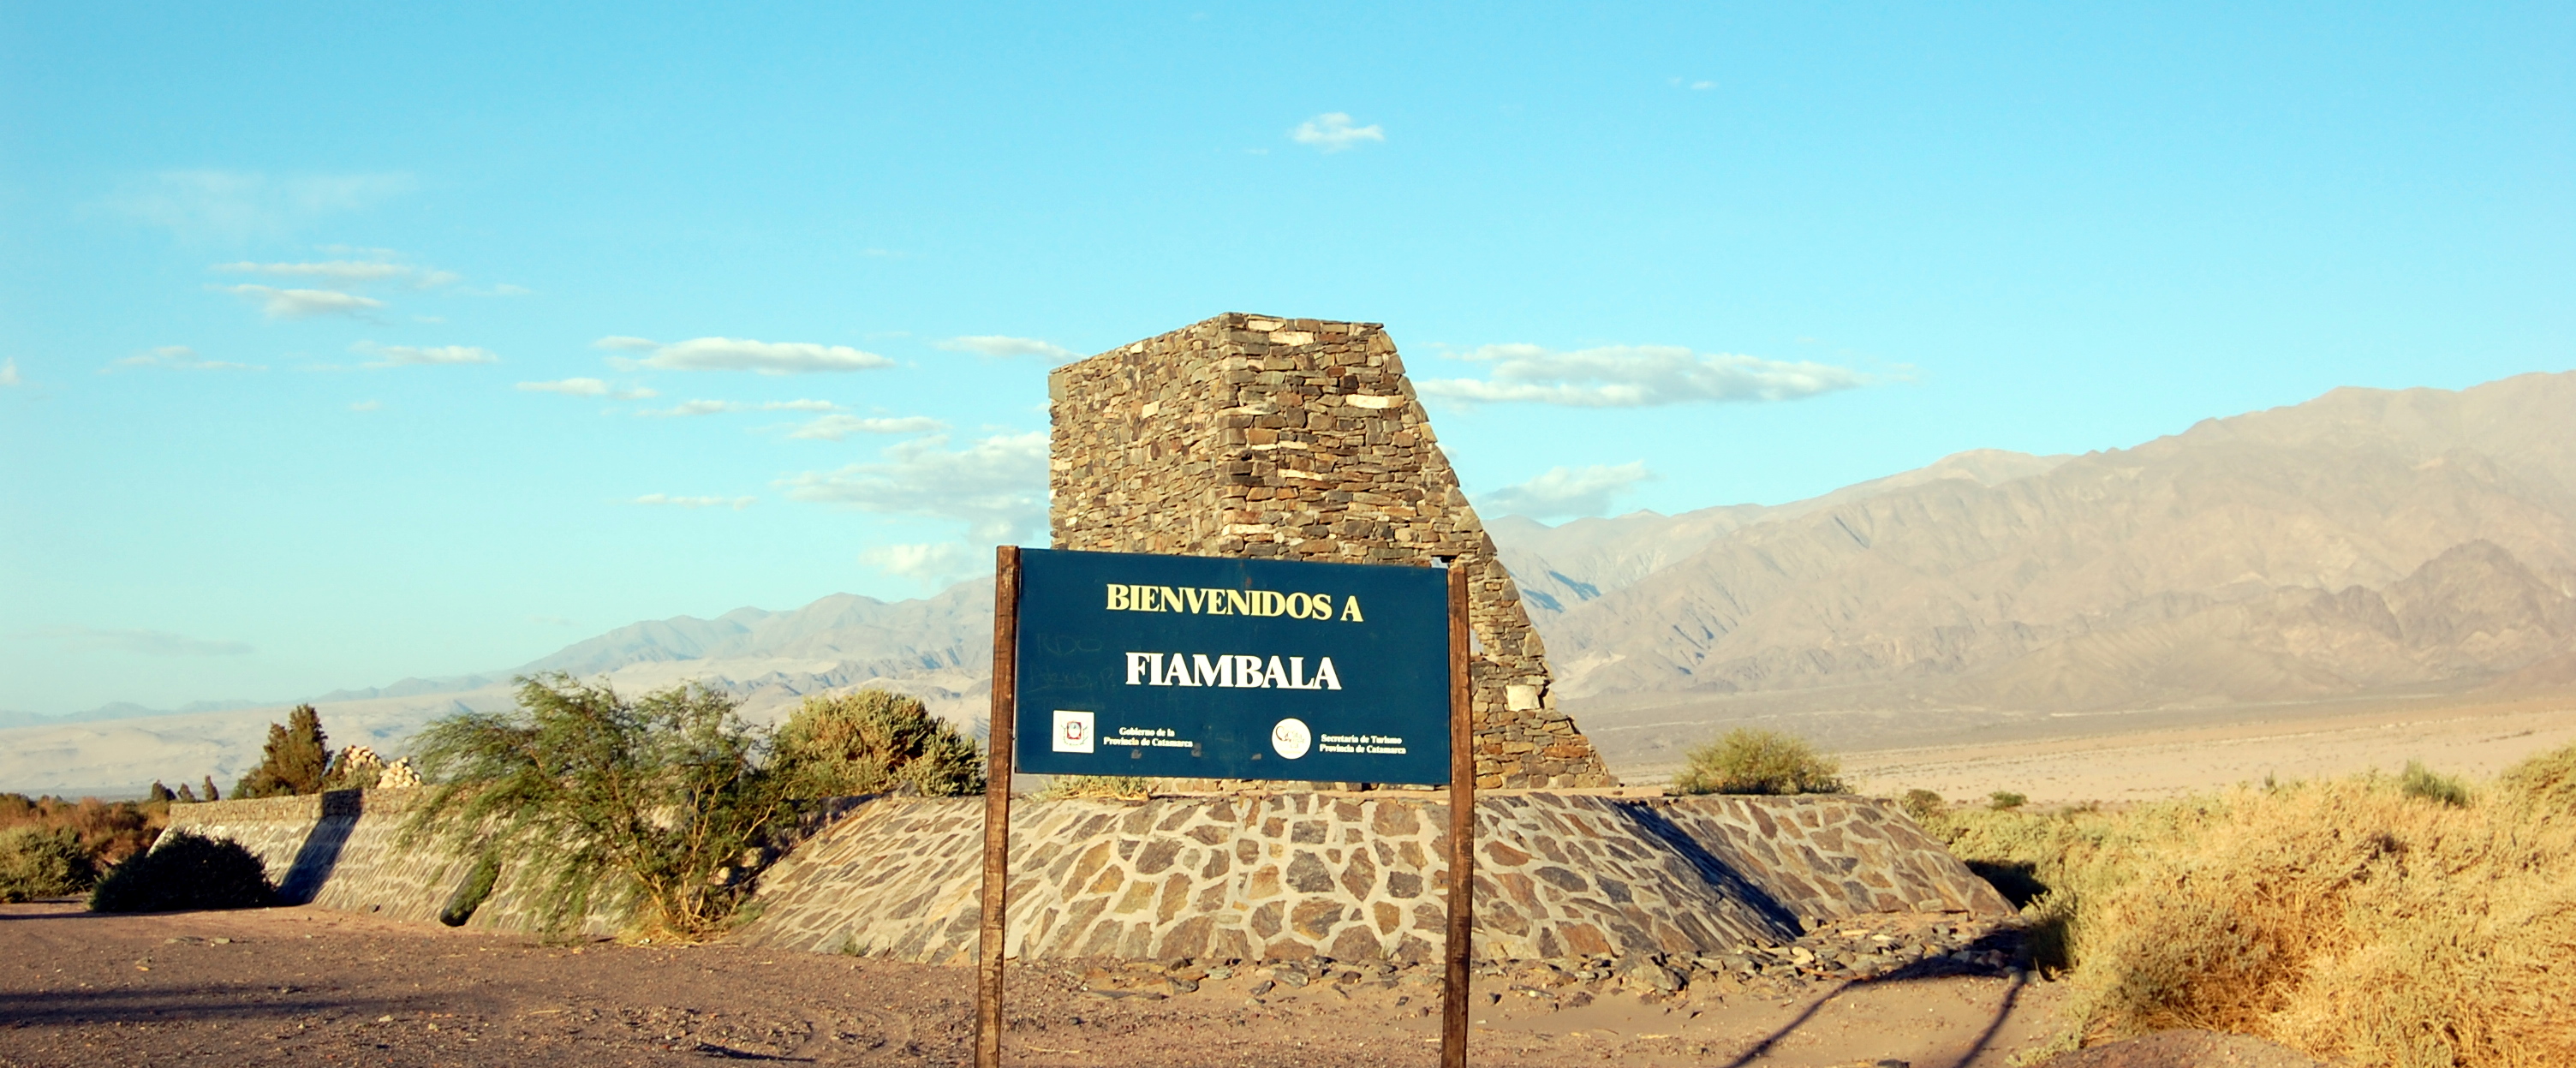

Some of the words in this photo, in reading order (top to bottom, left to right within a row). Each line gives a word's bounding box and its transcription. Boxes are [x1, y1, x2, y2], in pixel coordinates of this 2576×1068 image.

[1106, 583, 1333, 621] BIENVENIDOS
[1339, 595, 1364, 623] A
[1125, 652, 1343, 690] FIAMBALA
[1118, 726, 1155, 737] Gobierno
[1156, 727, 1166, 737] de
[1167, 728, 1175, 737] la
[1103, 736, 1140, 746] Provincia
[1141, 737, 1150, 746] de
[1152, 737, 1193, 748] Catamarca
[1360, 735, 1369, 743] de
[1370, 735, 1402, 744] Turismo
[1319, 743, 1355, 753] Provincia
[1356, 744, 1365, 753] de
[1366, 744, 1407, 755] Catamarca
